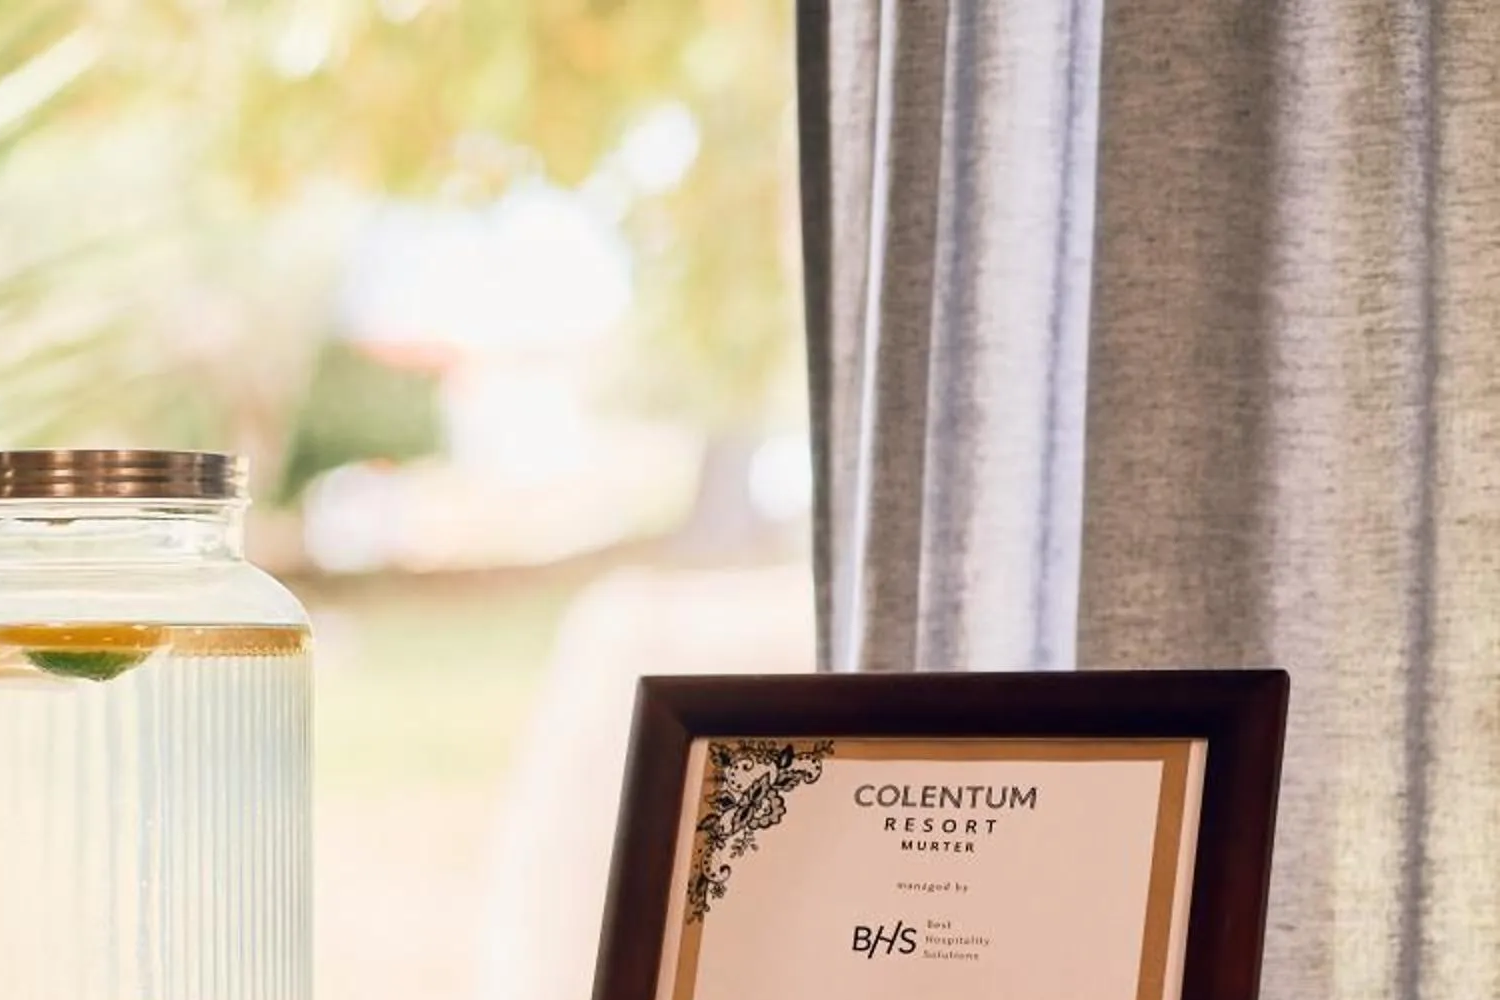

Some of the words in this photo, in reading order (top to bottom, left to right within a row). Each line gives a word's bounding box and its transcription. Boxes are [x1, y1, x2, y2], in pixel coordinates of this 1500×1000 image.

[853, 783, 1039, 811] COLENTUM
[883, 815, 998, 836] RESORT
[900, 839, 976, 855] MURTER
[851, 919, 918, 960] BHS
[924, 934, 991, 947] Hospitality
